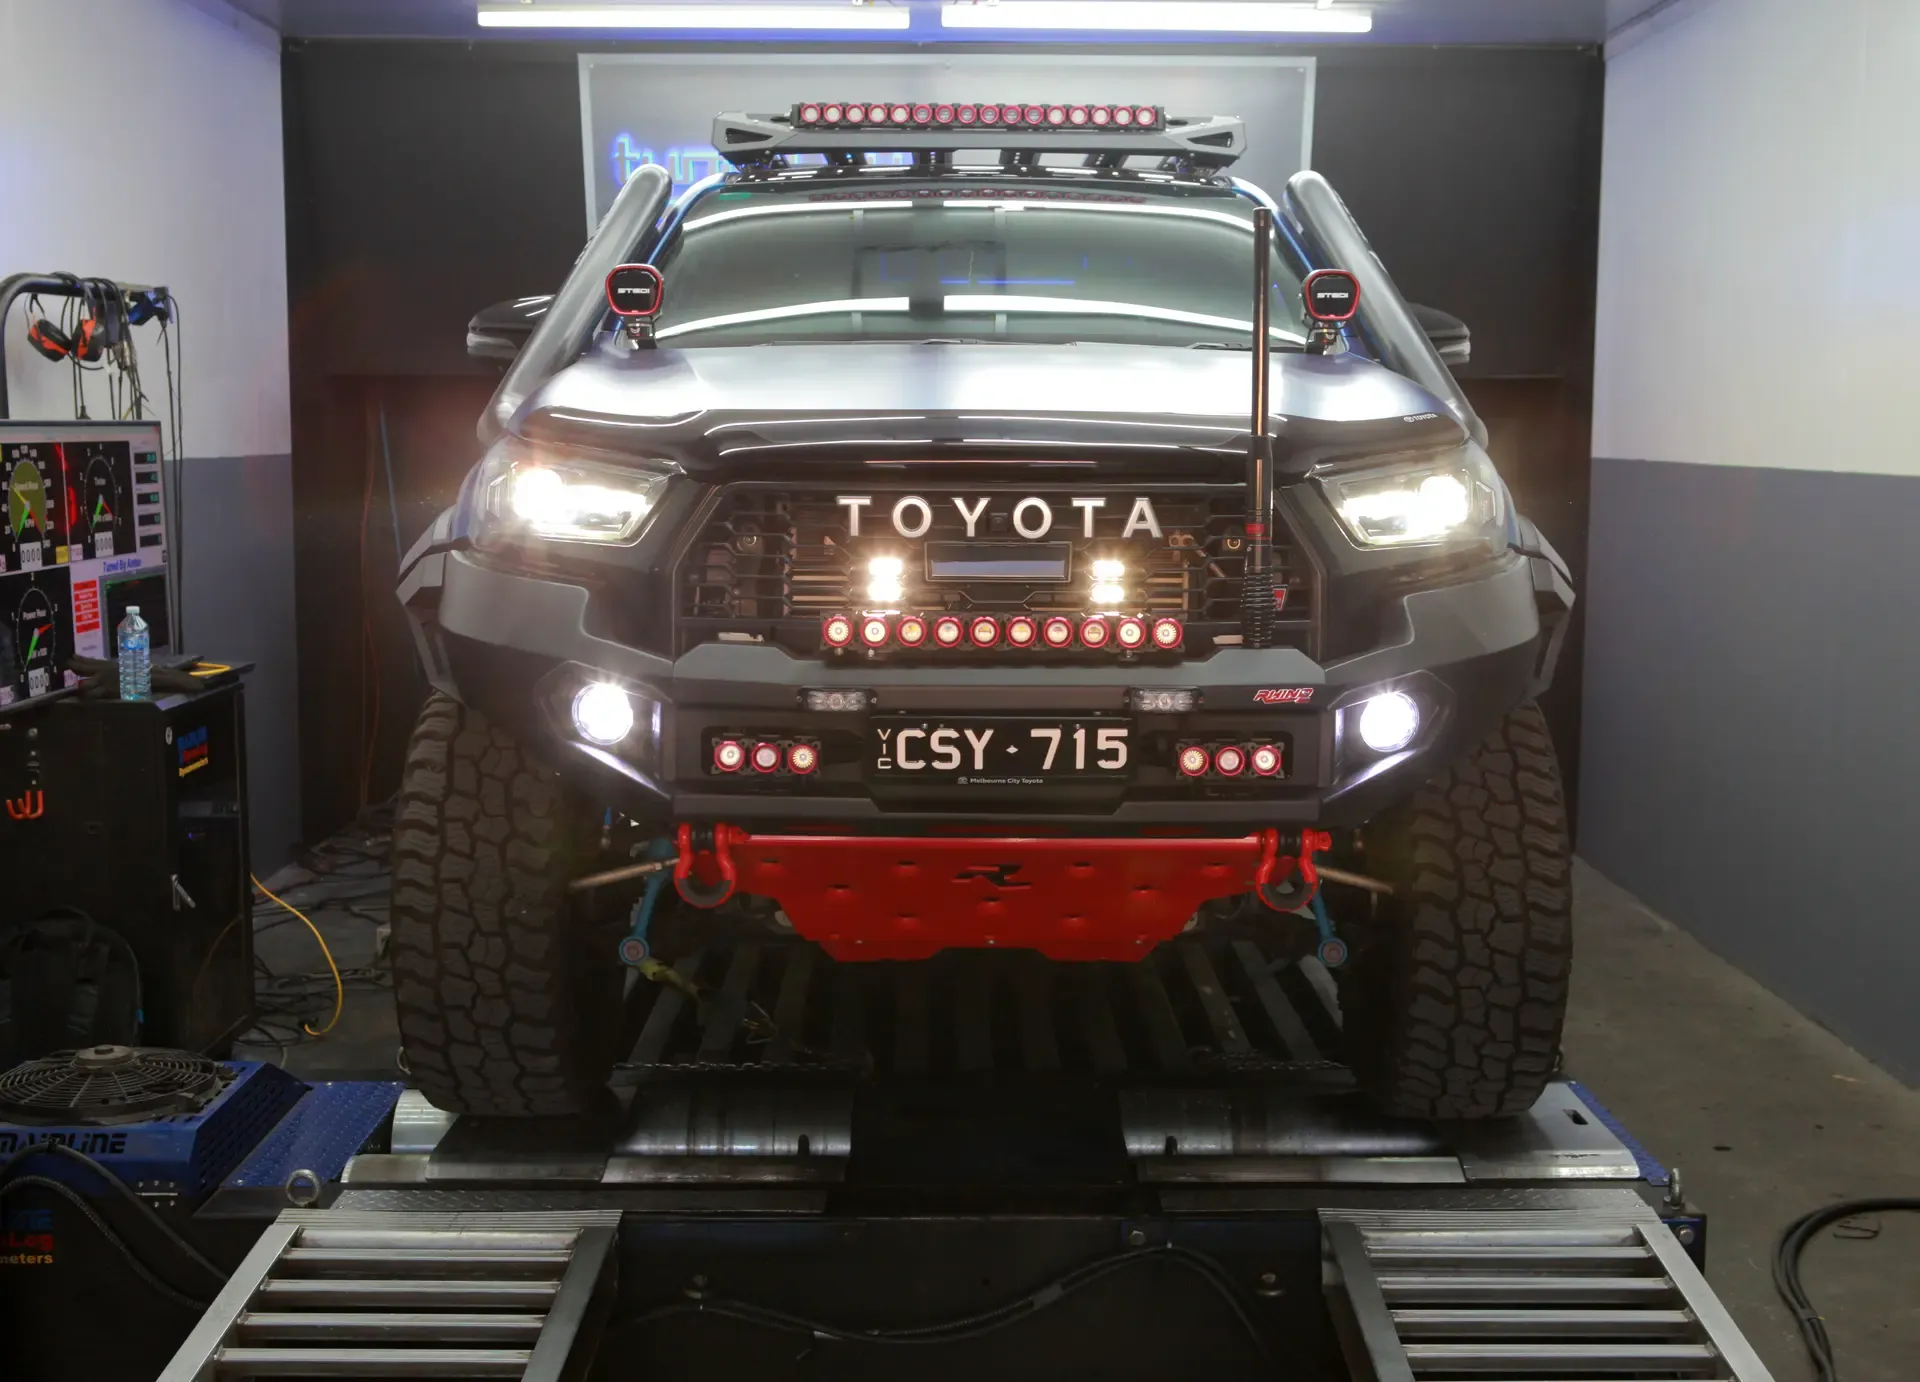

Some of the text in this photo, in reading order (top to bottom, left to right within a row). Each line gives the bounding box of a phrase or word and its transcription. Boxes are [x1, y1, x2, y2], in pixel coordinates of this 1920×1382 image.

[837, 496, 1163, 539] TOYOTA
[896, 728, 1129, 770] CSY 715
